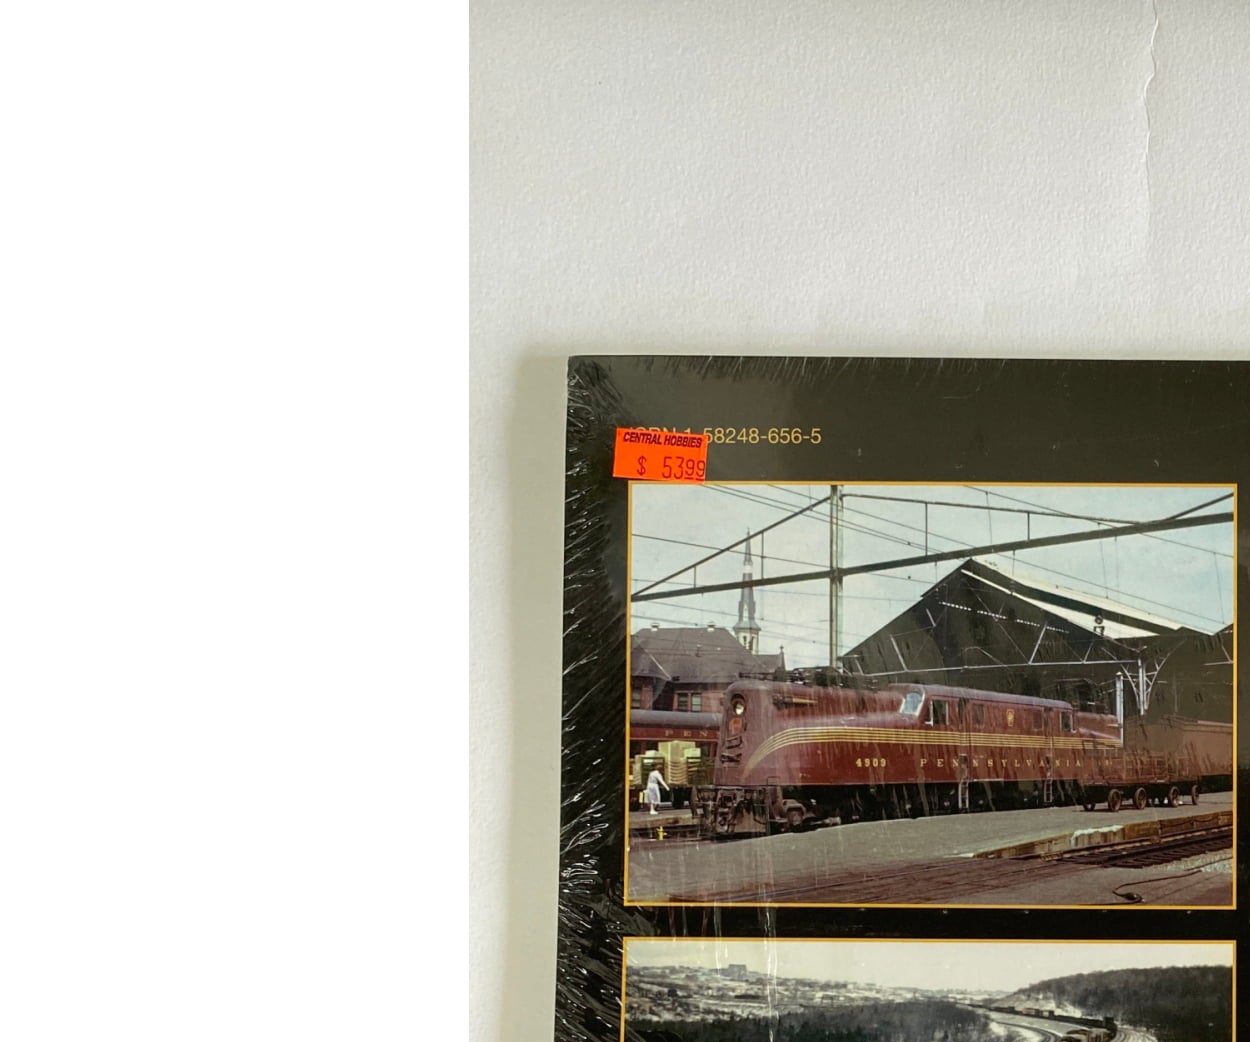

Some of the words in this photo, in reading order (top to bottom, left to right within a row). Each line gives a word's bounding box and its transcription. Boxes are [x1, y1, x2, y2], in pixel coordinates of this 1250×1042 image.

[623, 431, 662, 445] CENTRAL
[663, 434, 703, 449] HOBBIES
[686, 427, 823, 444] 58248-656-5
[636, 455, 647, 476] $
